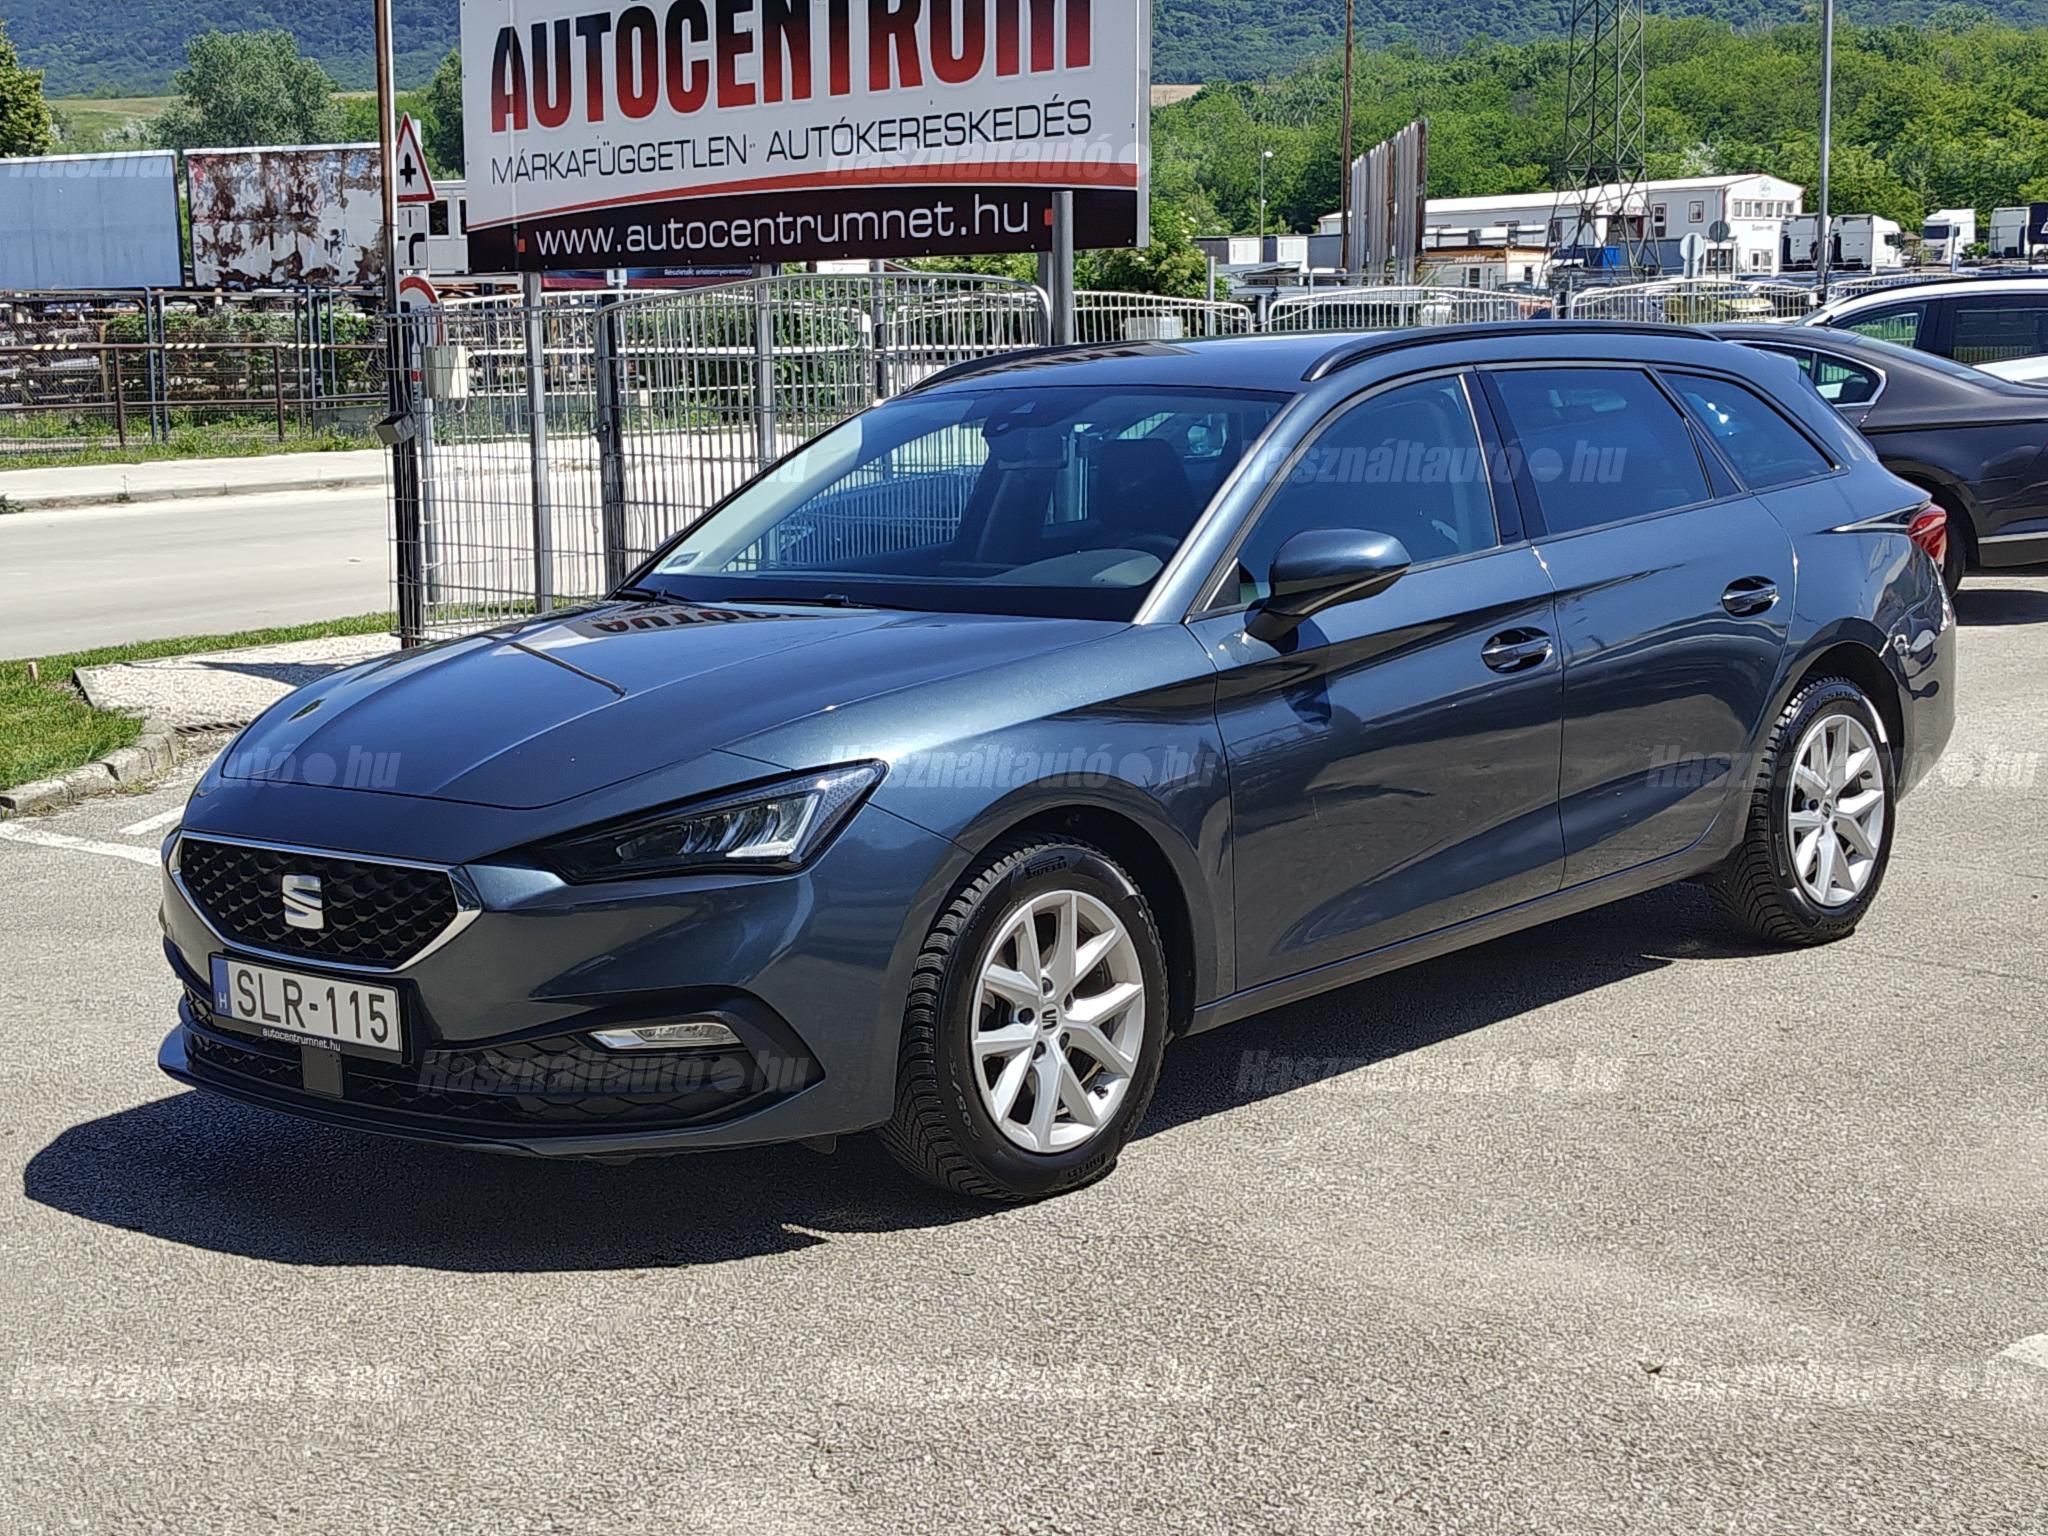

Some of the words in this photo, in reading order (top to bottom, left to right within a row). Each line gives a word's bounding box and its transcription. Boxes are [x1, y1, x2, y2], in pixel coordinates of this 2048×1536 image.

[492, 133, 747, 184] MÁRKAFÜGGETLEN
[766, 94, 1092, 163] AUTÓKERESKEDÉS
[536, 194, 1029, 255] www.autocentrumnet.hu
[219, 992, 228, 1010] H
[237, 969, 389, 1044] SLR-115
[262, 1027, 341, 1051] autocentrumnet.hu
